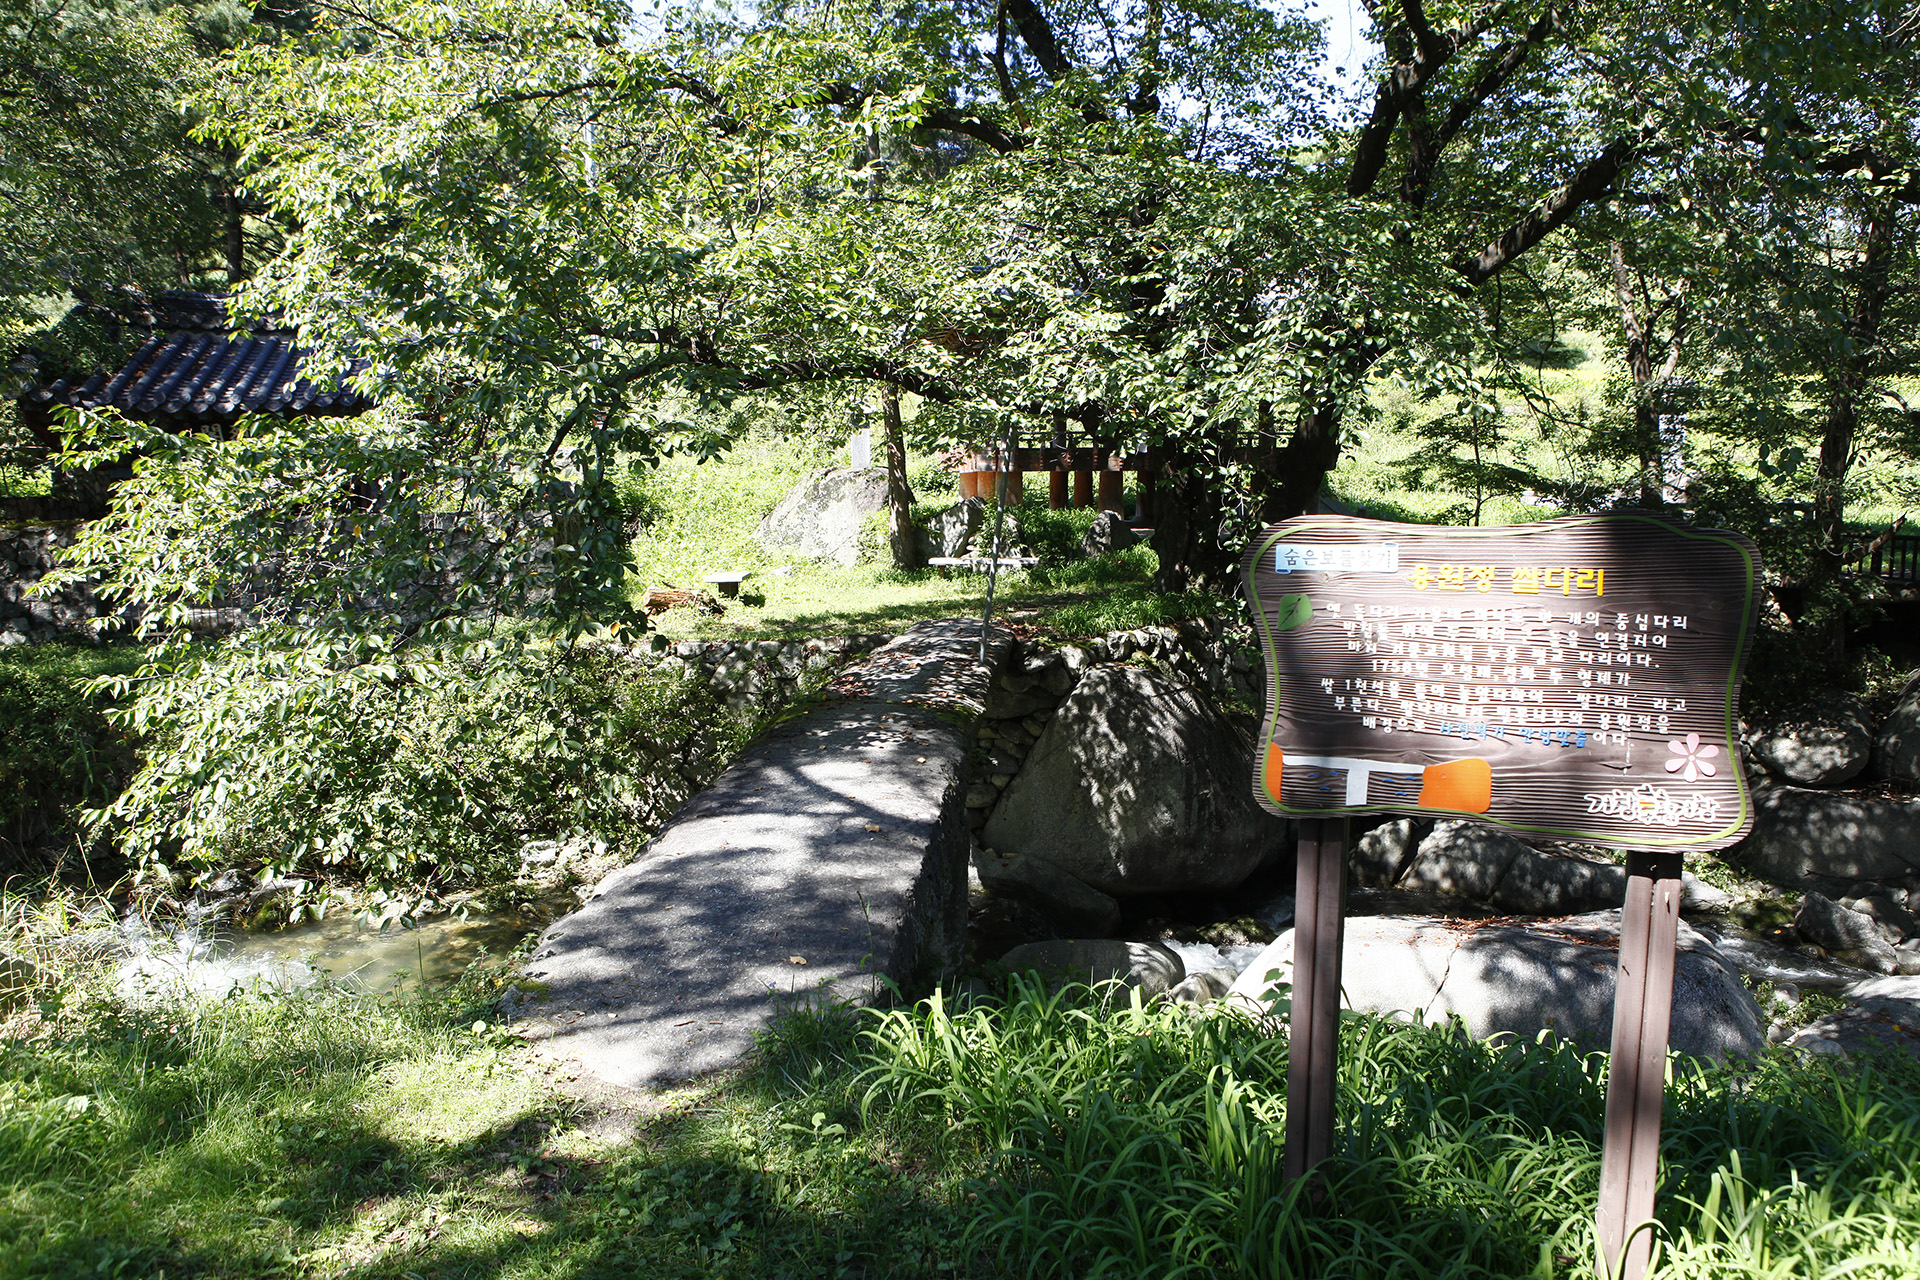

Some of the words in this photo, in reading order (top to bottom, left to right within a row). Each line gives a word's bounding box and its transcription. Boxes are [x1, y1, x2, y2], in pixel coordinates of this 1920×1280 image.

[1408, 564, 1496, 593] 용원정
[1510, 567, 1605, 597] 쌀다리
[1353, 604, 1399, 621] 돌다리
[1414, 606, 1461, 623] 가운데
[1538, 610, 1553, 626] 한
[1567, 612, 1600, 626] 개의
[1616, 613, 1687, 631] 중심다리
[1550, 630, 1580, 647] 돌을
[1595, 631, 1667, 650] 연결지어
[1349, 640, 1377, 654] 마치
[1580, 651, 1660, 668] 다리이다.
[1550, 669, 1563, 684] 두
[1577, 669, 1631, 688] 형제가
[1321, 678, 1335, 694] 쌀
[1345, 678, 1400, 699] 1천석을
[1653, 697, 1687, 712] 라고
[1335, 696, 1388, 713] 부른다.
[1599, 713, 1670, 734] 용원정을
[1363, 716, 1426, 735] 배경으로
